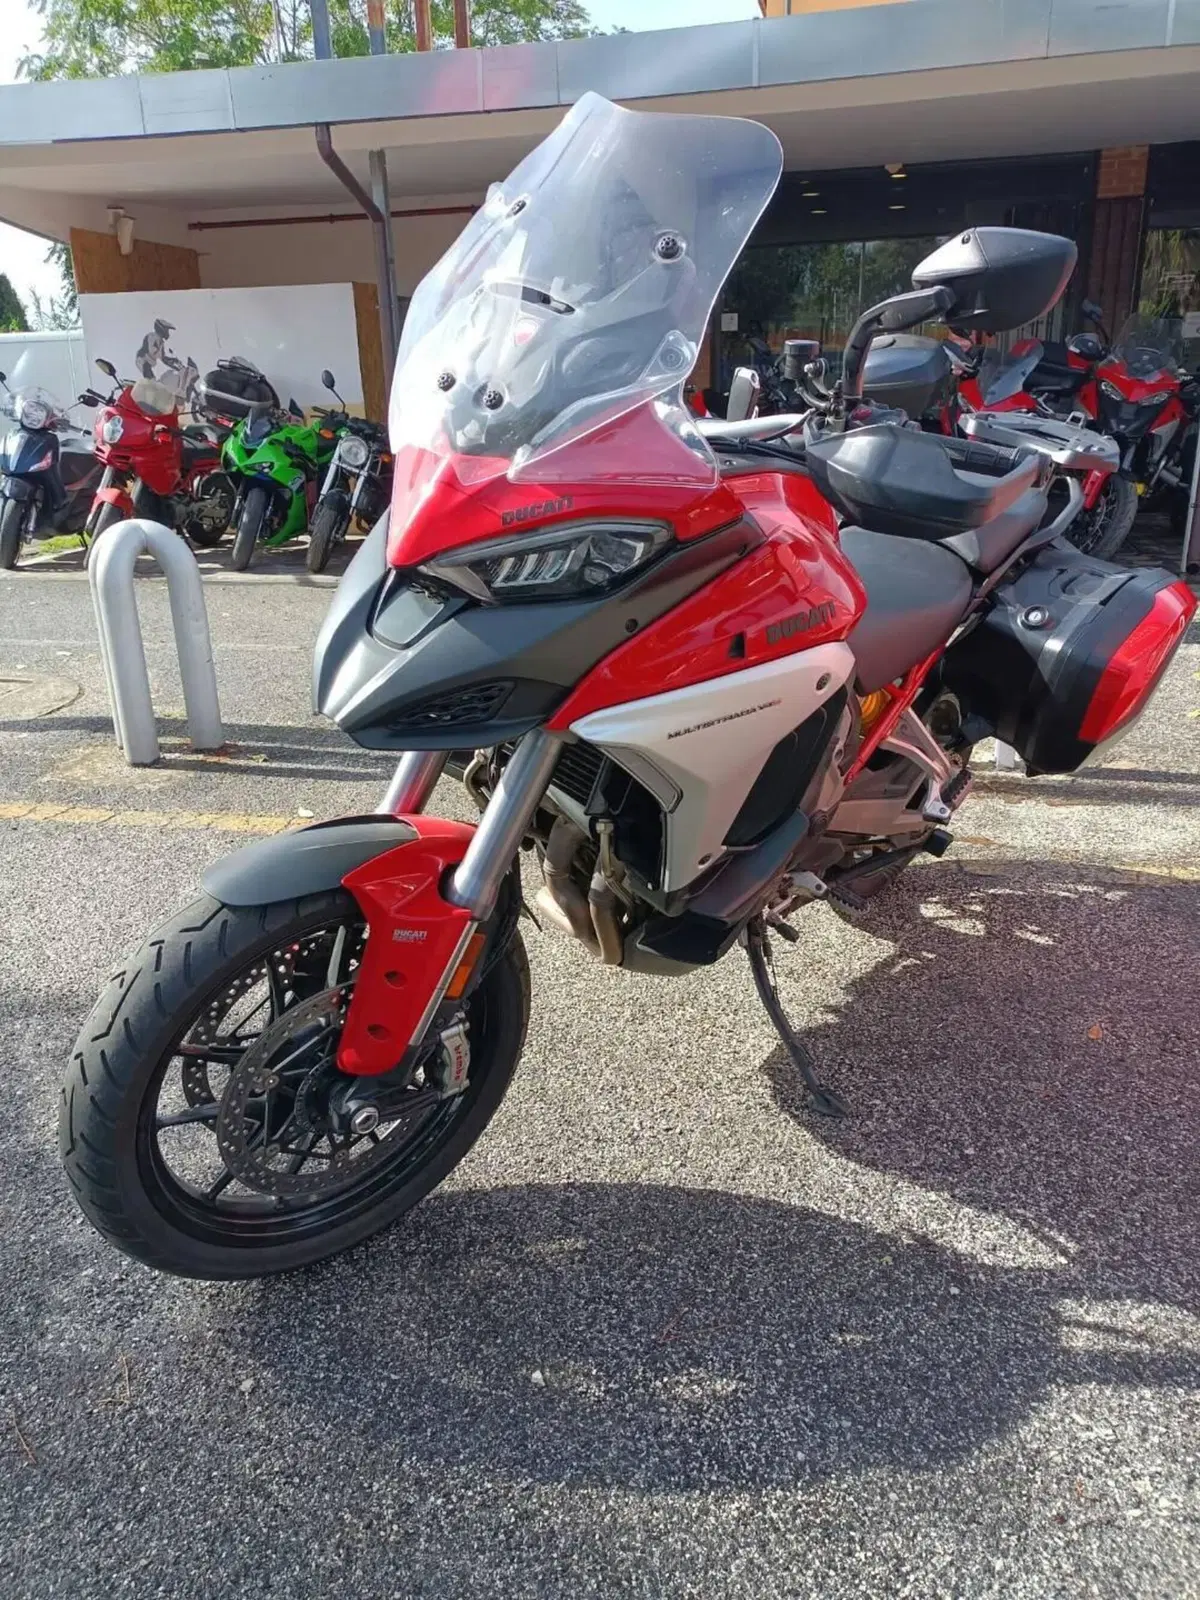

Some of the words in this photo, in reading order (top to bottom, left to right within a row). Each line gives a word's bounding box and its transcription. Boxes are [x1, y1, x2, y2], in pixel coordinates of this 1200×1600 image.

[502, 495, 573, 526] DUCATI
[766, 601, 835, 644] DUCATI
[392, 929, 427, 940] DUCATI
